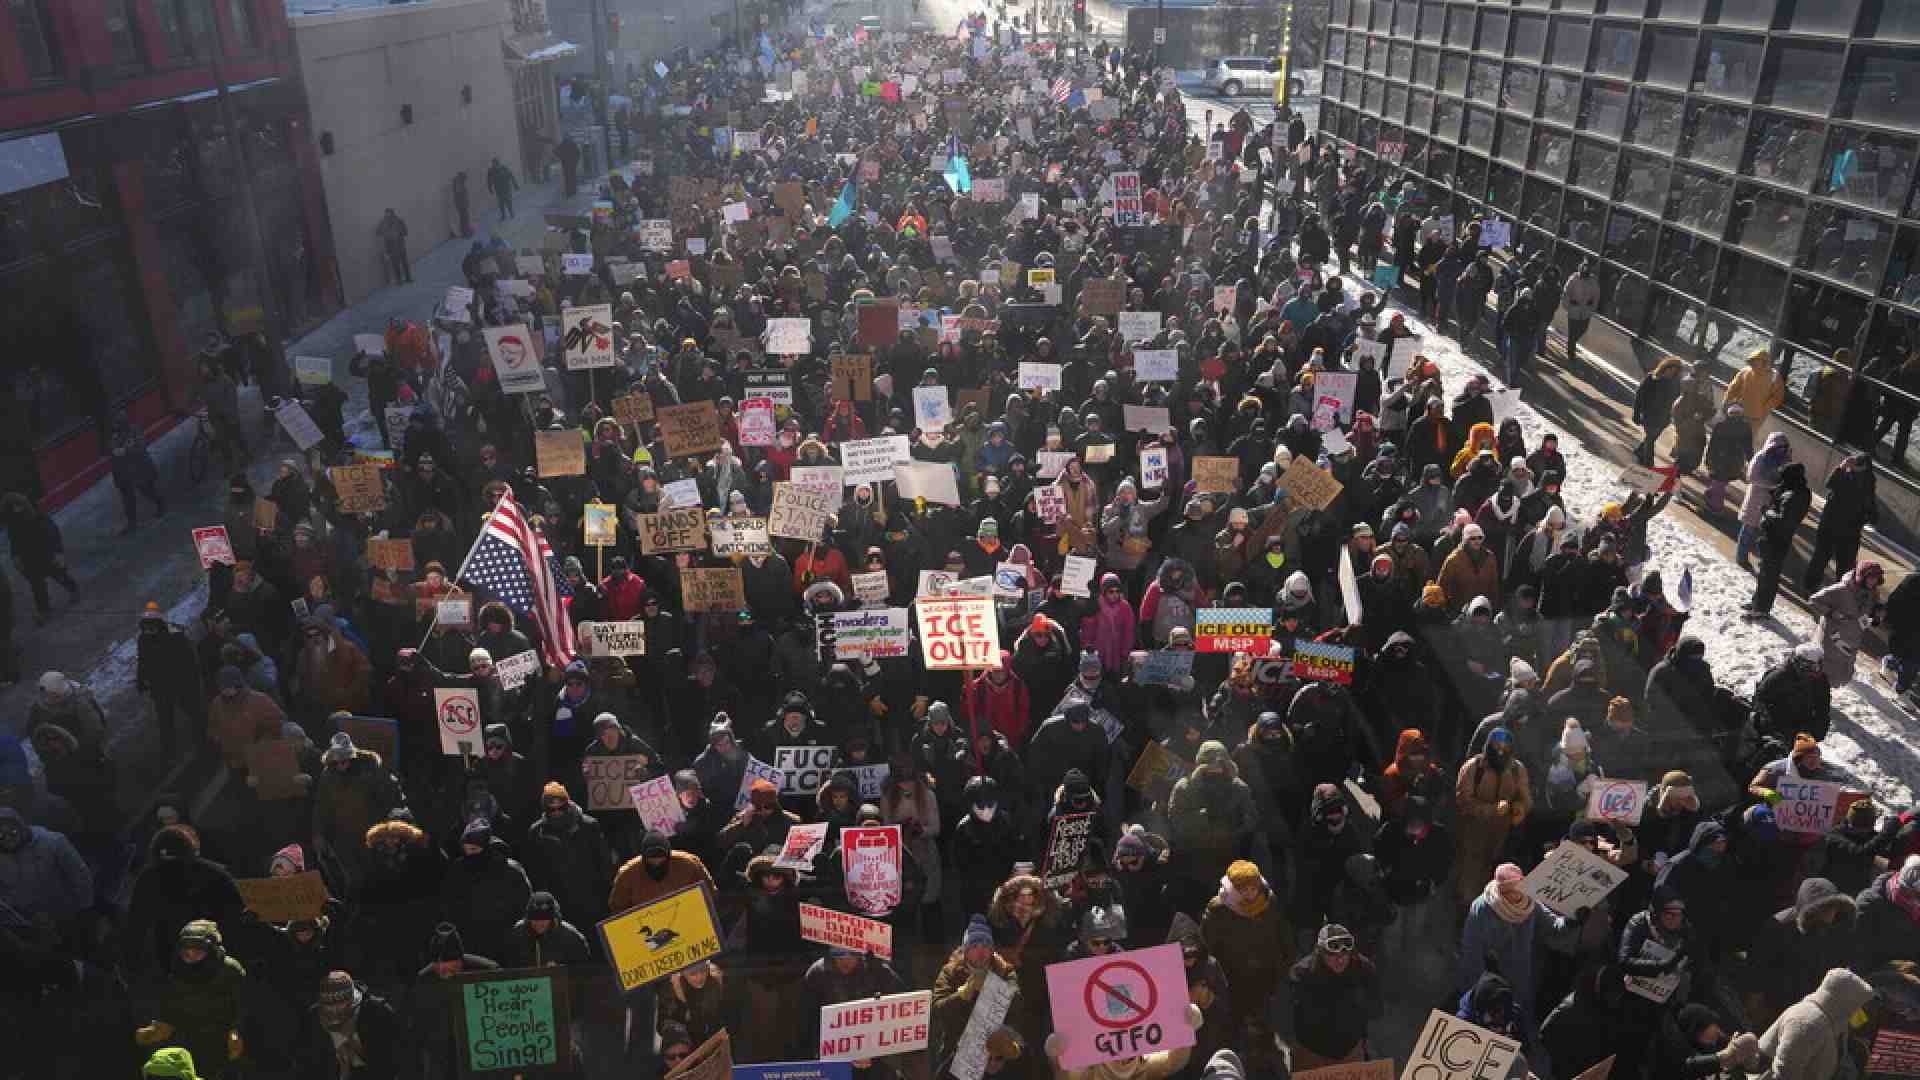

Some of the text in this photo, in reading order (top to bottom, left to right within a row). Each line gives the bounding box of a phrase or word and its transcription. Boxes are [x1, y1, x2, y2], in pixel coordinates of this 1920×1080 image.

[645, 511, 699, 533] HANDS
[653, 528, 692, 546] OFF
[593, 624, 616, 633] SAY
[925, 614, 984, 638] ICE
[1198, 624, 1271, 636] ICE OUT
[930, 640, 991, 662] OUT!
[1213, 637, 1254, 650] MSP
[1296, 653, 1352, 672] ICE OUT
[1307, 666, 1338, 677] MSP
[592, 759, 638, 780] ICE
[1780, 783, 1822, 801] ICE
[1794, 801, 1833, 818] OUT
[825, 921, 866, 938] OUR
[475, 983, 540, 1000] Do you
[483, 998, 533, 1014] Hear
[830, 999, 928, 1029] JUSTICE
[481, 1008, 549, 1042] People
[821, 1023, 928, 1057] NOT LIES
[1095, 1023, 1163, 1055] GTFO
[1421, 1017, 1516, 1080] ICE
[474, 1035, 553, 1070] Sing?
